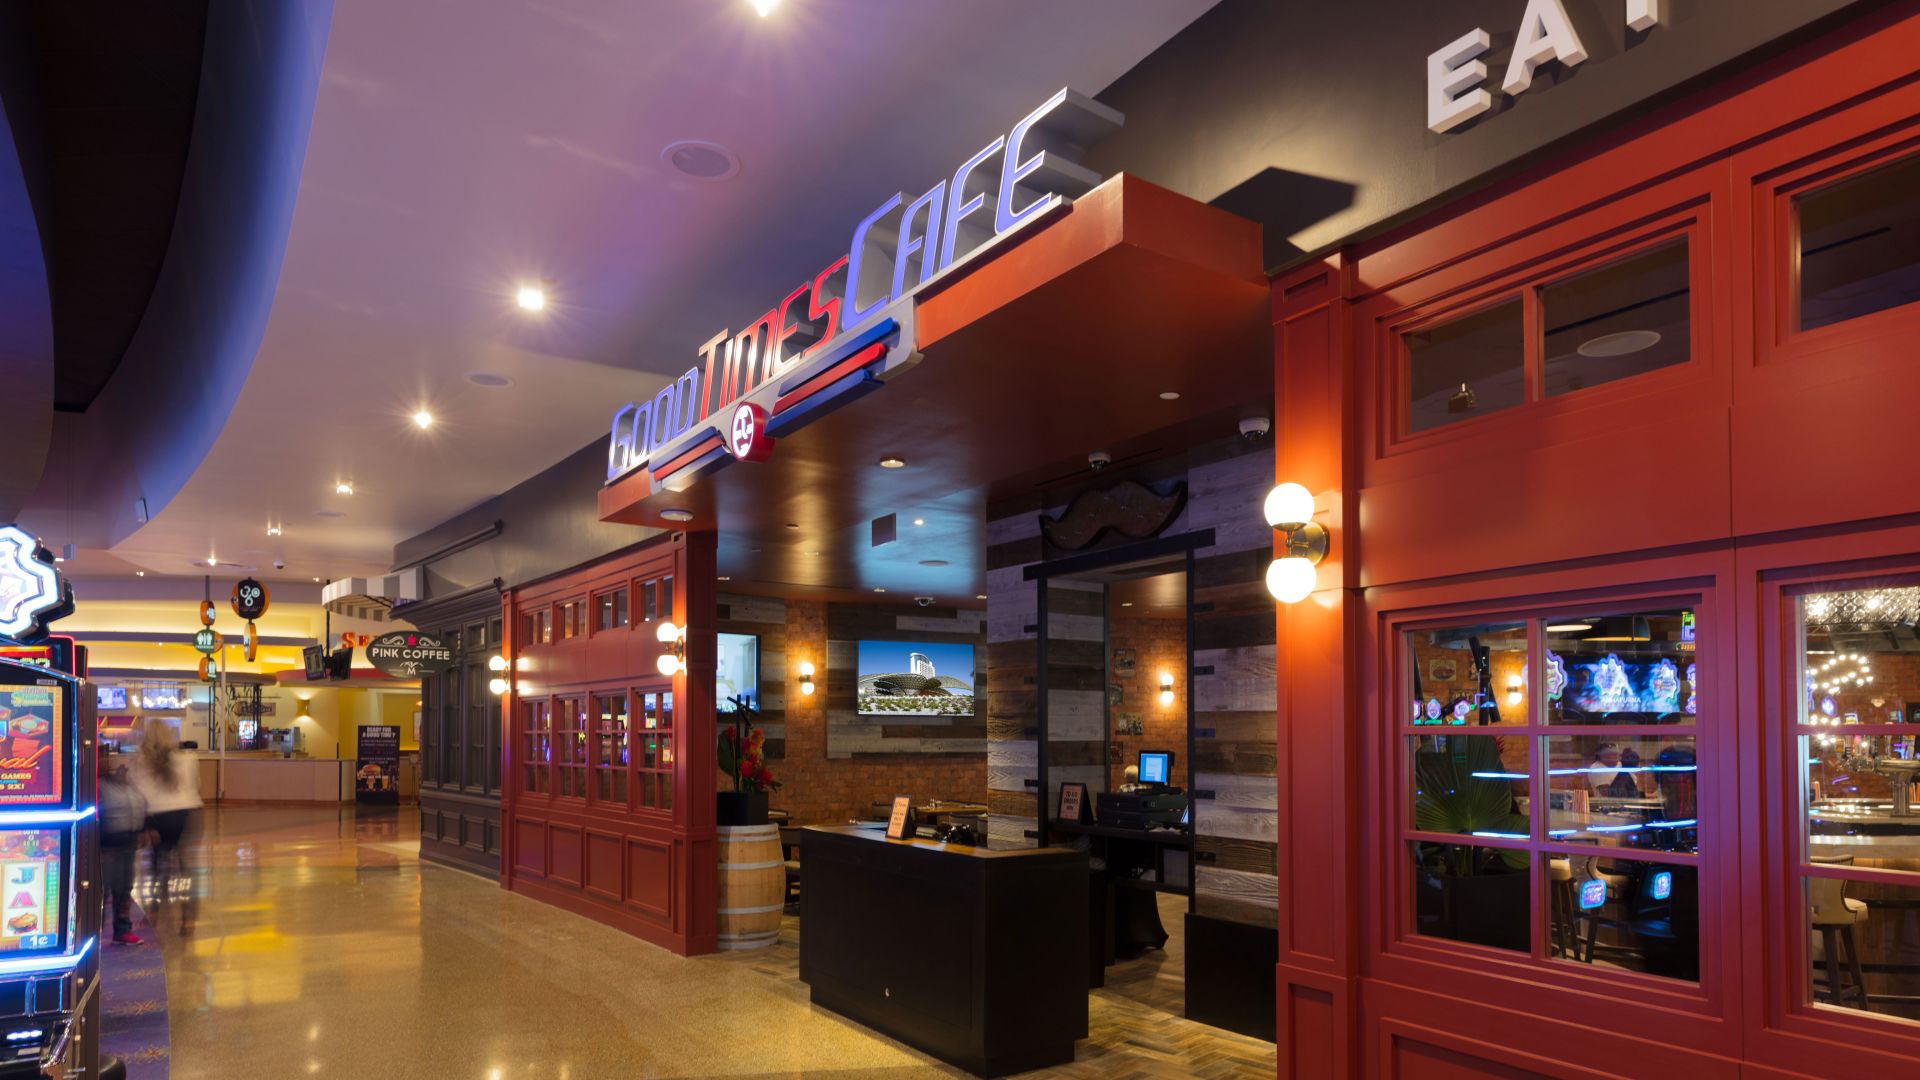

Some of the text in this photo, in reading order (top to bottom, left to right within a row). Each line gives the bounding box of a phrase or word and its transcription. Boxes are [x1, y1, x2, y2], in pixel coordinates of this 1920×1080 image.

[1427, 0, 1658, 134] EA
[607, 86, 1068, 481] GOOD TIMES CAFE
[372, 647, 450, 661] PINK COFFEE
